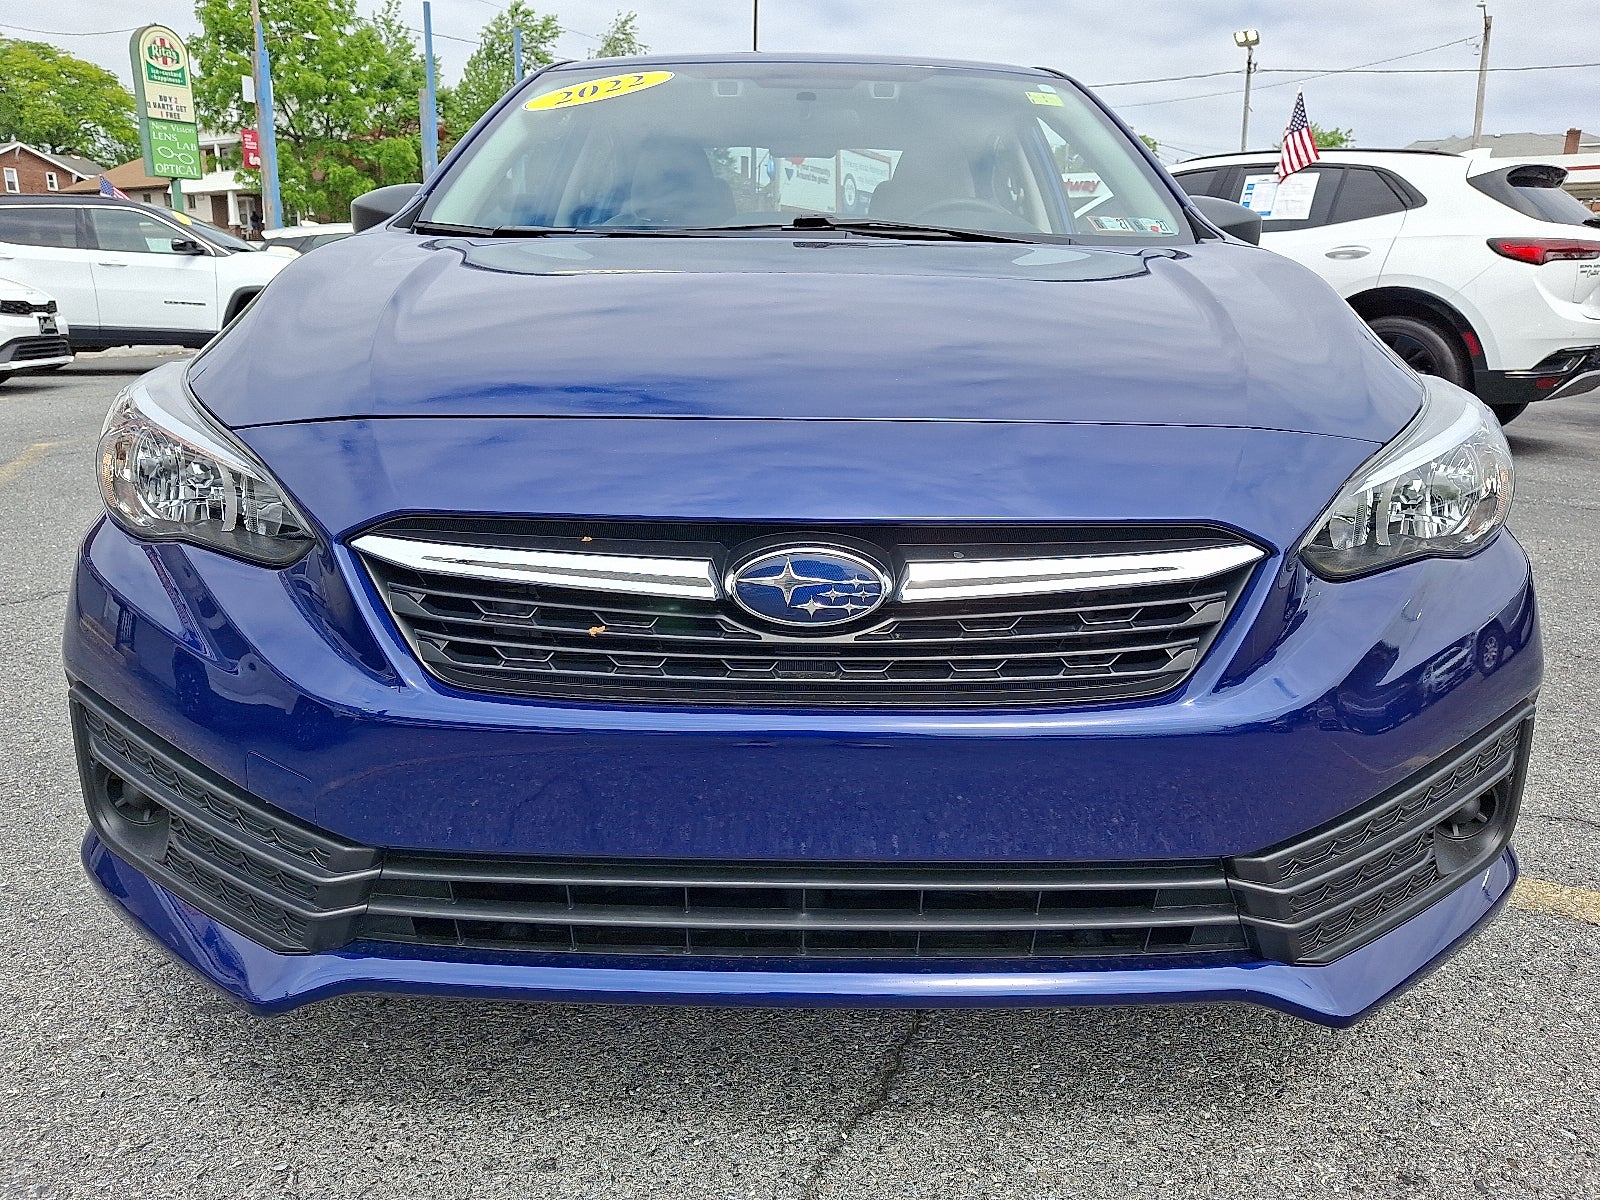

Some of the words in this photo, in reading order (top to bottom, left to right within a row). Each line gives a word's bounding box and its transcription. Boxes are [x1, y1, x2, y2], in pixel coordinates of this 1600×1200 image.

[152, 44, 178, 59] Rita's
[553, 75, 645, 105] 2022
[158, 95, 173, 103] BUY
[175, 105, 187, 113] GET
[165, 112, 181, 120] FREE
[151, 122, 168, 131] New
[152, 131, 178, 142] LENS
[176, 142, 197, 151] LAB
[155, 163, 200, 177] OPTICAL
